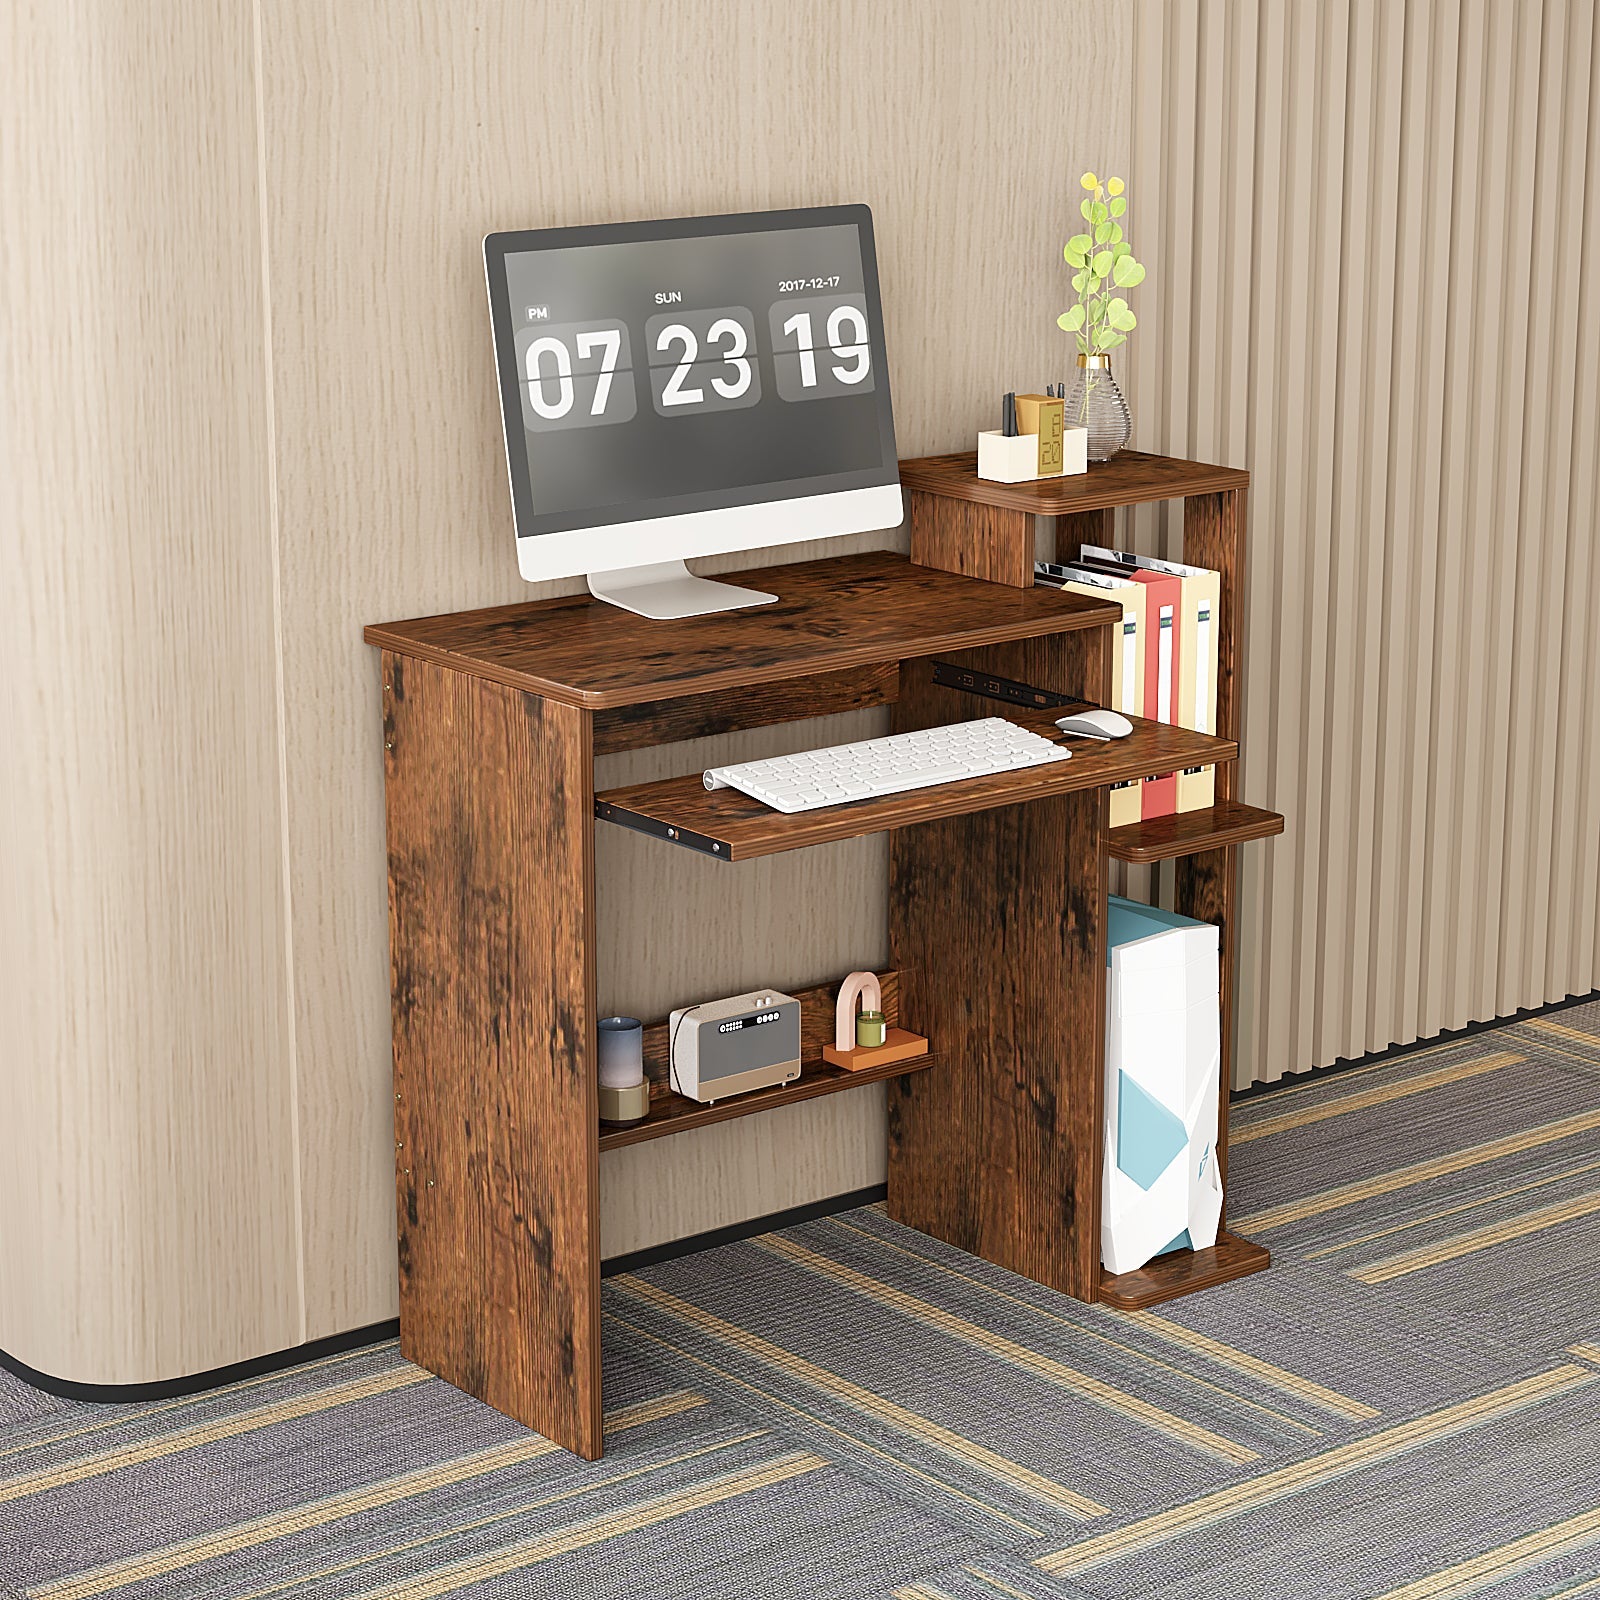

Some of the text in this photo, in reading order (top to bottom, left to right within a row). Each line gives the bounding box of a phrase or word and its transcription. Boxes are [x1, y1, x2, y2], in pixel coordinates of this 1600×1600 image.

[778, 275, 841, 292] 2017-12-17
[654, 291, 682, 305] SUN
[527, 306, 548, 320] PM
[525, 305, 870, 420] 07 23 19
